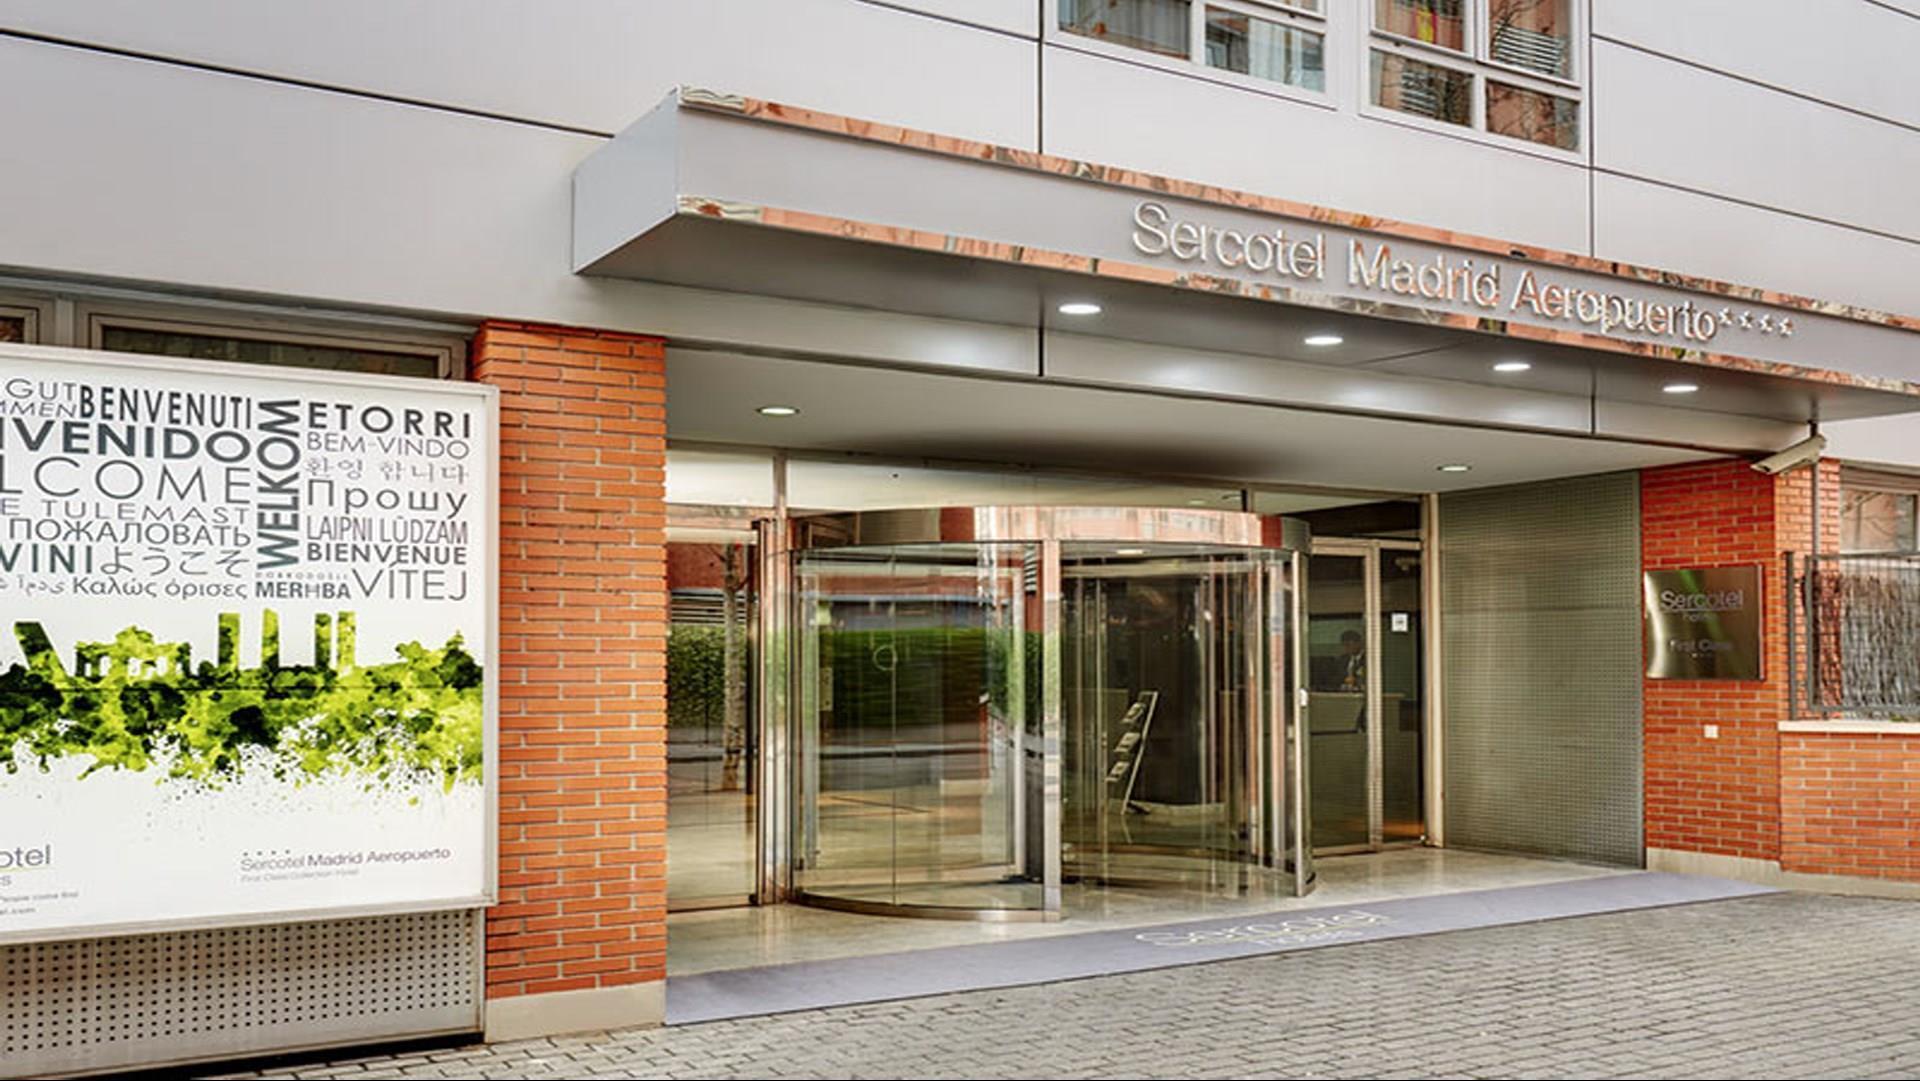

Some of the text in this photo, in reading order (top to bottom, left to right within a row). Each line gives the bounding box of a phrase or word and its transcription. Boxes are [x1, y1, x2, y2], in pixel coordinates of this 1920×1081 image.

[1131, 201, 1717, 343] Sercotel Madrid Aeropuerto
[5, 378, 77, 401] GUT
[0, 400, 77, 418] MEN
[80, 384, 251, 430] BENVENUTI
[308, 402, 470, 439] ETORRI
[0, 417, 252, 463] VENIDO
[306, 431, 470, 460] BEM-VINDO
[0, 453, 251, 504] LCOME
[256, 399, 301, 570] WELKOM
[41, 499, 249, 524] TULEMAST
[308, 478, 468, 519] Прошу
[9, 518, 252, 547] ПОЖАЛОВАТЬ
[307, 515, 373, 542] LAIPNI
[0, 543, 93, 574] VINI
[100, 545, 250, 578] ようこそ
[307, 543, 467, 565] BIENVENUE
[1661, 588, 1744, 611] Sercotel
[241, 848, 451, 872] Sercotel Madrid Aeropuerto
